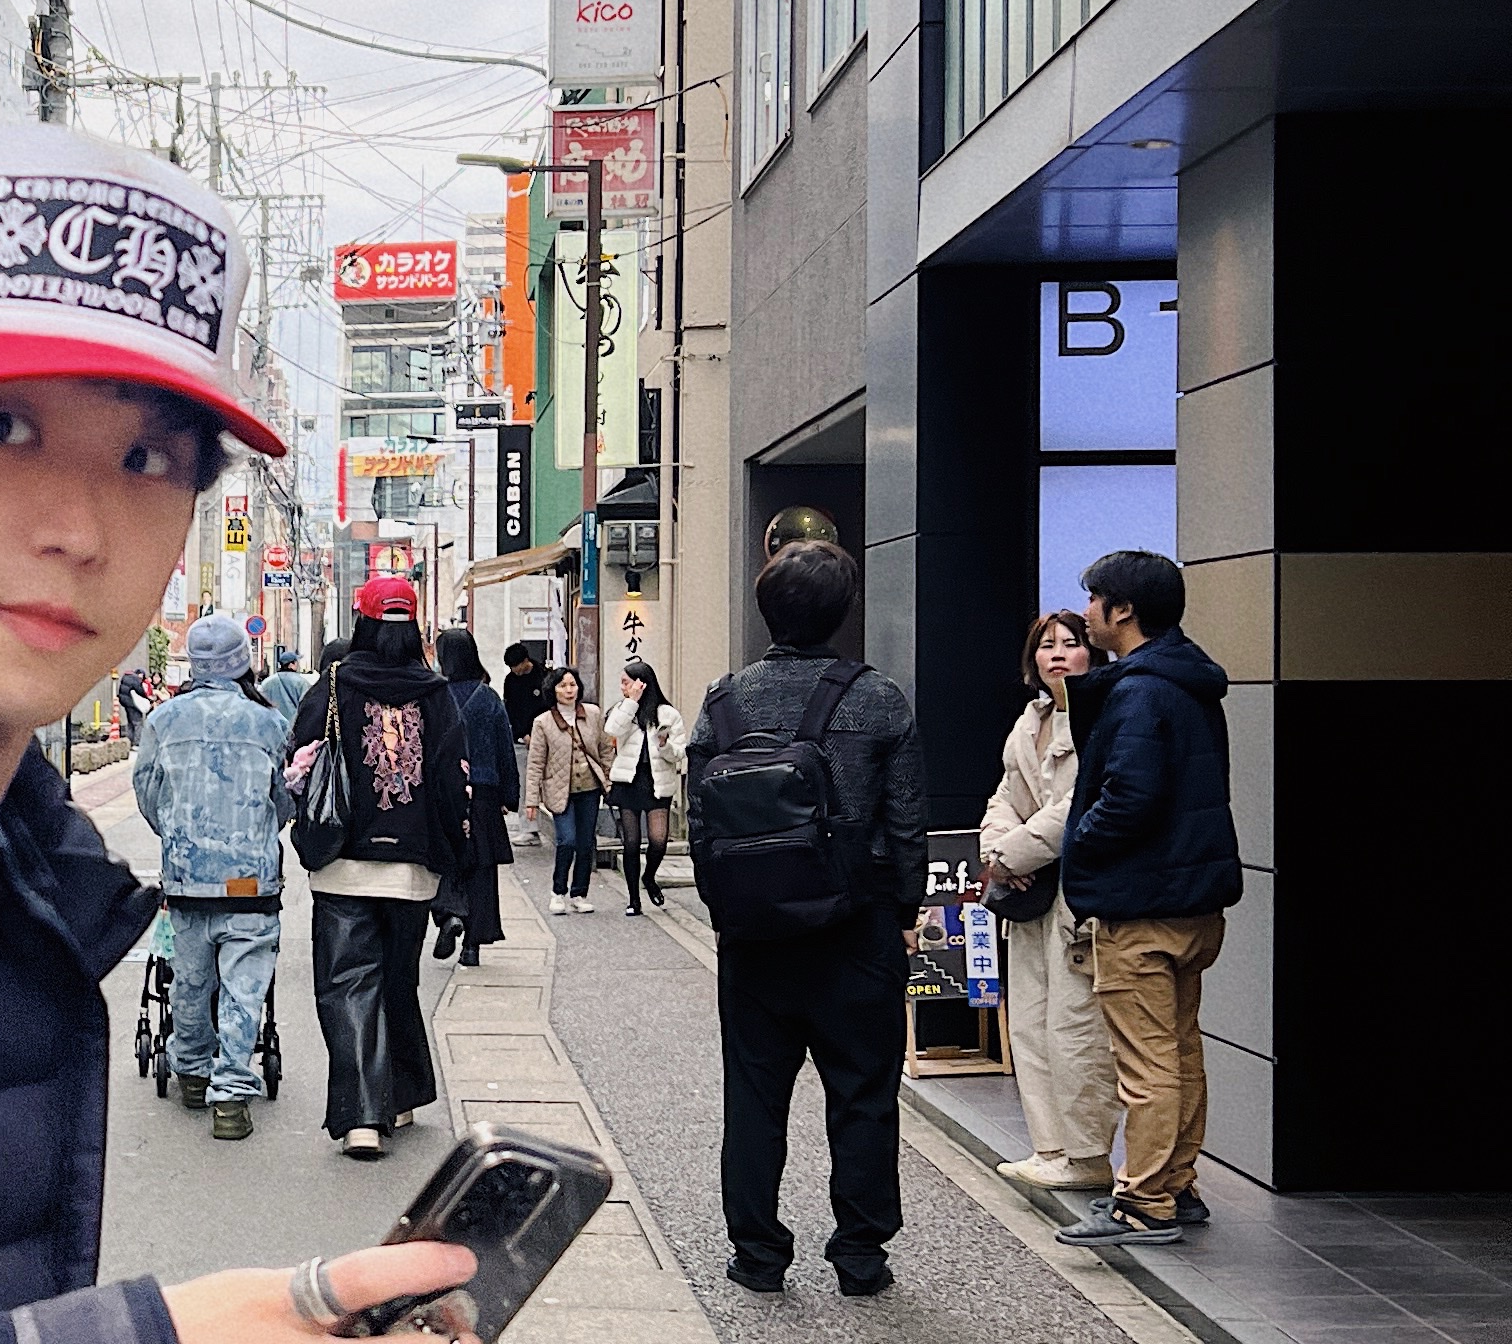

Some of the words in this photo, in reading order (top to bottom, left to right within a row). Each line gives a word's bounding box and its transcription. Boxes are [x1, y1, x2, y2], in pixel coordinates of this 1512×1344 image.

[48, 204, 178, 301] CH
[375, 251, 451, 273] カラオケ
[622, 610, 645, 664] 牛かつ
[971, 908, 992, 974] 営業中
[906, 984, 941, 996] OPEN
